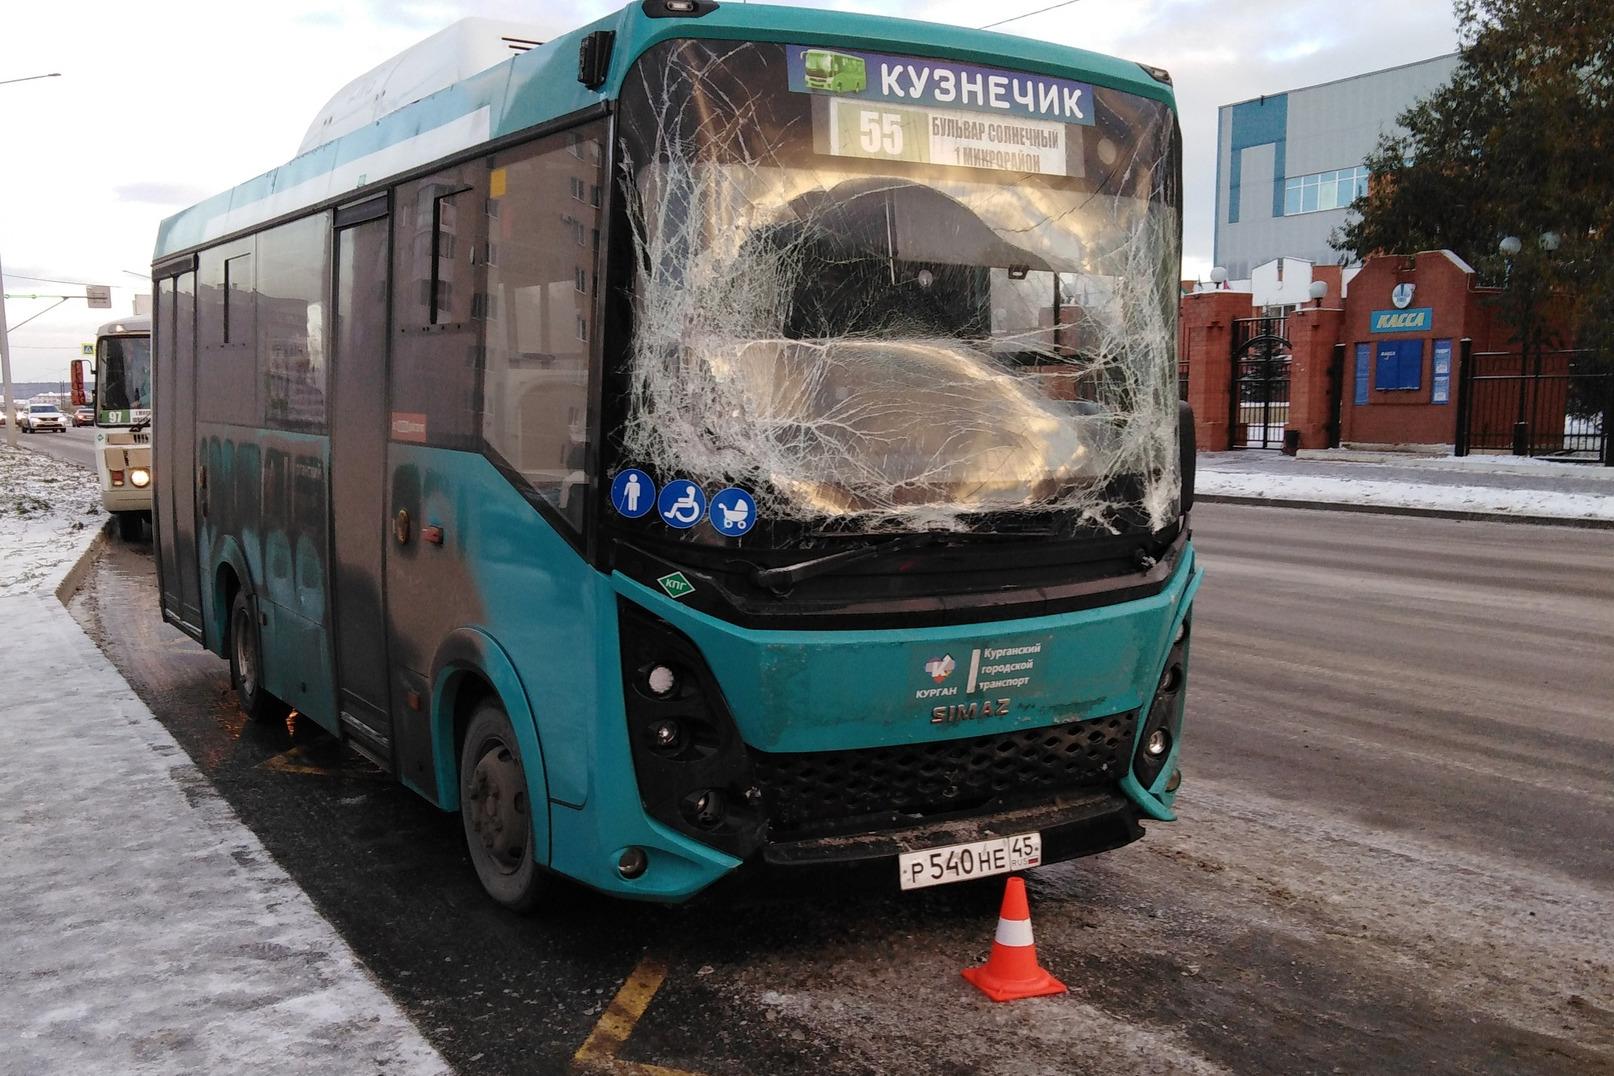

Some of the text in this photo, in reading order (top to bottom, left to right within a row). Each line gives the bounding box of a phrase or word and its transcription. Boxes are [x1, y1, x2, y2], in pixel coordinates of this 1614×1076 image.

[881, 63, 1083, 119] КУЗНЕЧИК
[860, 110, 903, 156] 55
[932, 116, 1059, 149] БУЛЬВАР СОЛНЕЧНЫЙ
[955, 147, 1040, 172] 1 МИКРОРАЙОН
[1377, 312, 1425, 328] КАССА
[109, 411, 122, 423] 97
[665, 578, 686, 590] КПГ
[984, 643, 1041, 659] Курганский
[981, 659, 1034, 675] городской
[979, 677, 1030, 692] транспорт
[916, 687, 957, 699] КУРГАН
[931, 698, 1011, 724] SIMAZ
[1012, 836, 1033, 858] 45
